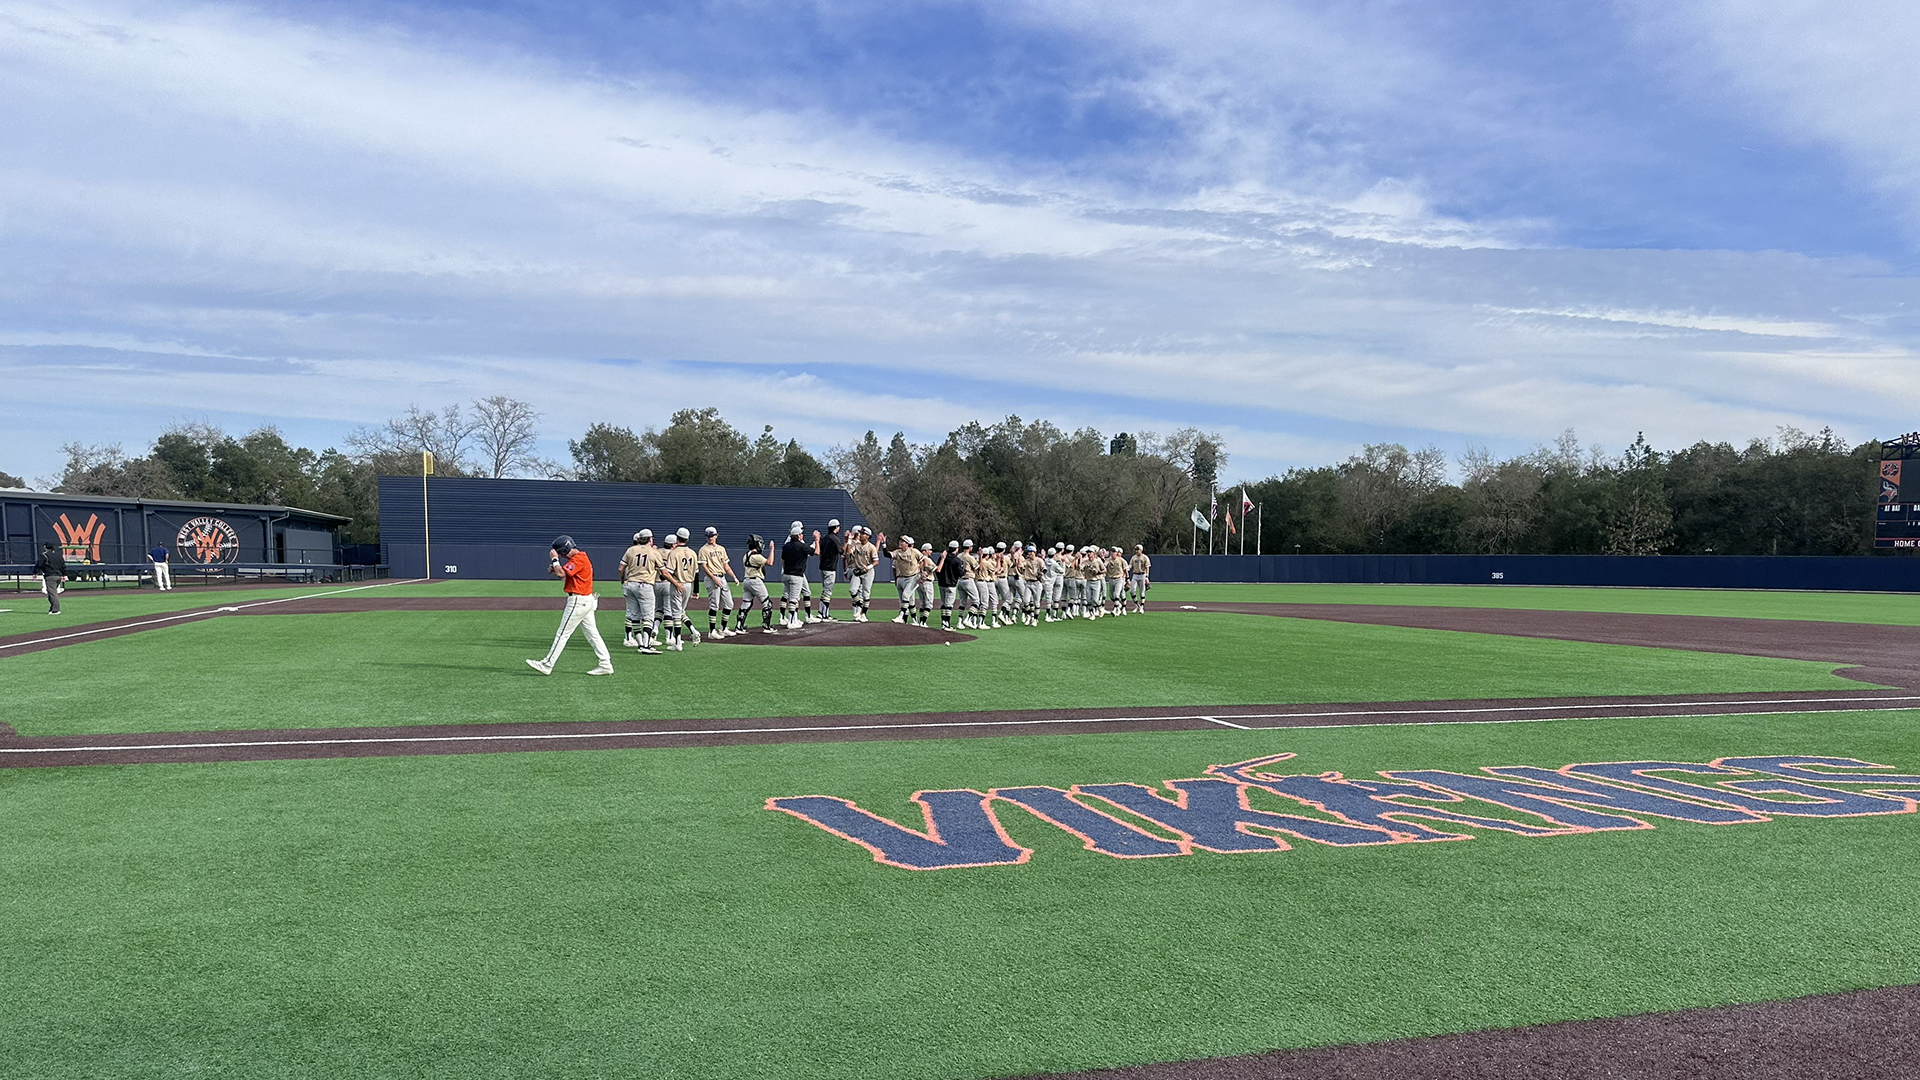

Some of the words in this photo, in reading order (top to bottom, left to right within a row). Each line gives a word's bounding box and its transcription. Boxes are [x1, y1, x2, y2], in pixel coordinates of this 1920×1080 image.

[1894, 540, 1916, 548] HOME
[635, 553, 648, 567] 11
[681, 557, 693, 571] 21
[445, 565, 457, 573] 310
[764, 752, 1920, 872] VIKINGS
